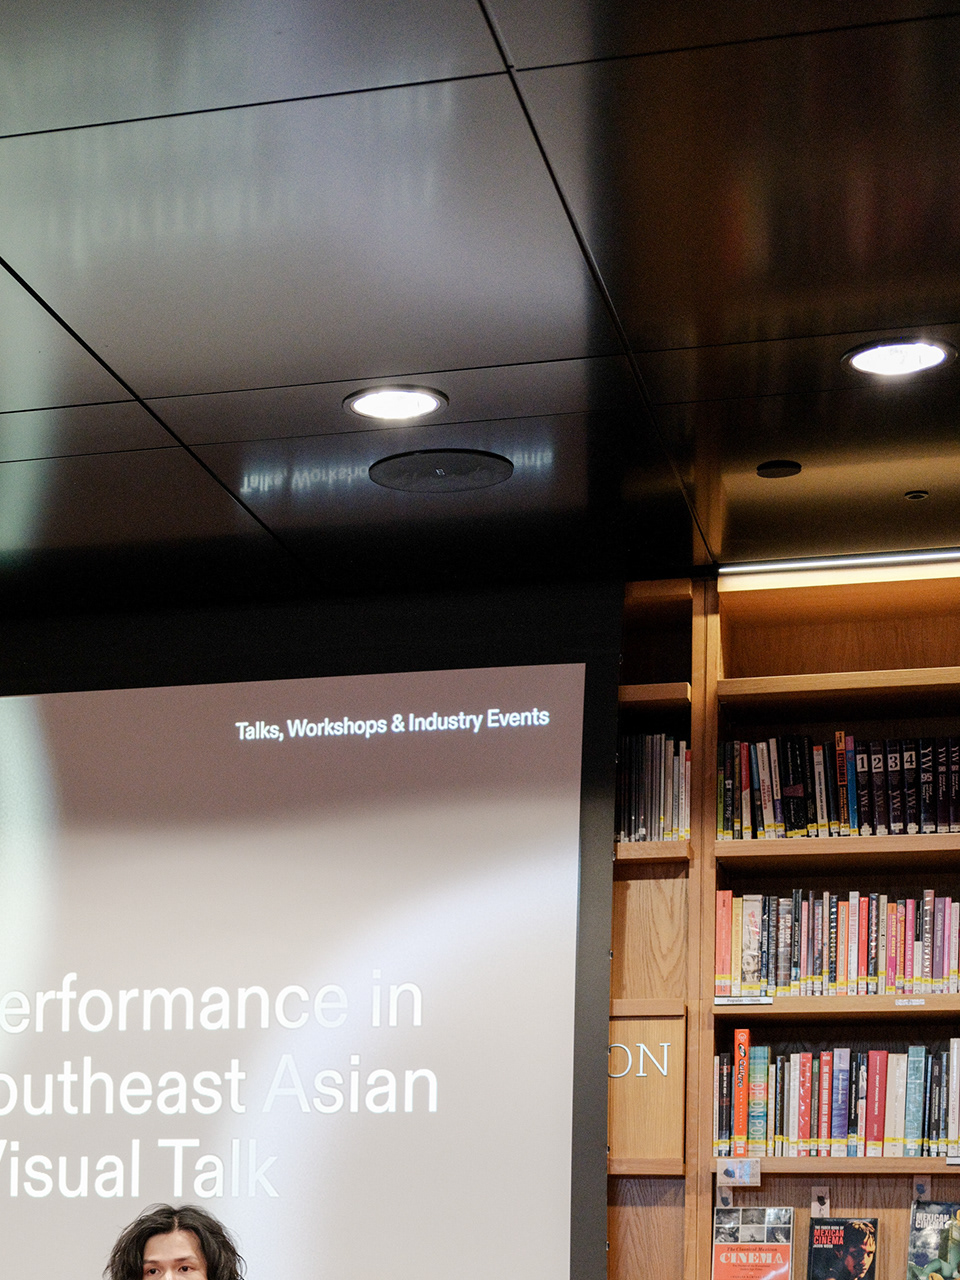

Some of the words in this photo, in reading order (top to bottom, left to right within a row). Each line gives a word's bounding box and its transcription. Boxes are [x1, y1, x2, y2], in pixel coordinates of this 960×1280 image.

[235, 721, 284, 741] Talks,
[287, 717, 388, 739] Workshops
[390, 713, 406, 733] &
[408, 712, 483, 733] Industry
[487, 708, 550, 728] Events
[371, 968, 424, 1028] in
[737, 1059, 746, 1088] Culture
[822, 1065, 830, 1073] THE
[262, 1052, 439, 1115] Asian
[751, 1074, 764, 1097] HOP
[751, 1100, 764, 1116] ON
[157, 1137, 280, 1198] Talk
[915, 1220, 943, 1228] CINEMA
[916, 1213, 949, 1222] MEXICAN
[813, 1237, 844, 1245] CINEMA
[814, 1229, 844, 1237] MEXICAN
[720, 1252, 783, 1264] CINEMA
